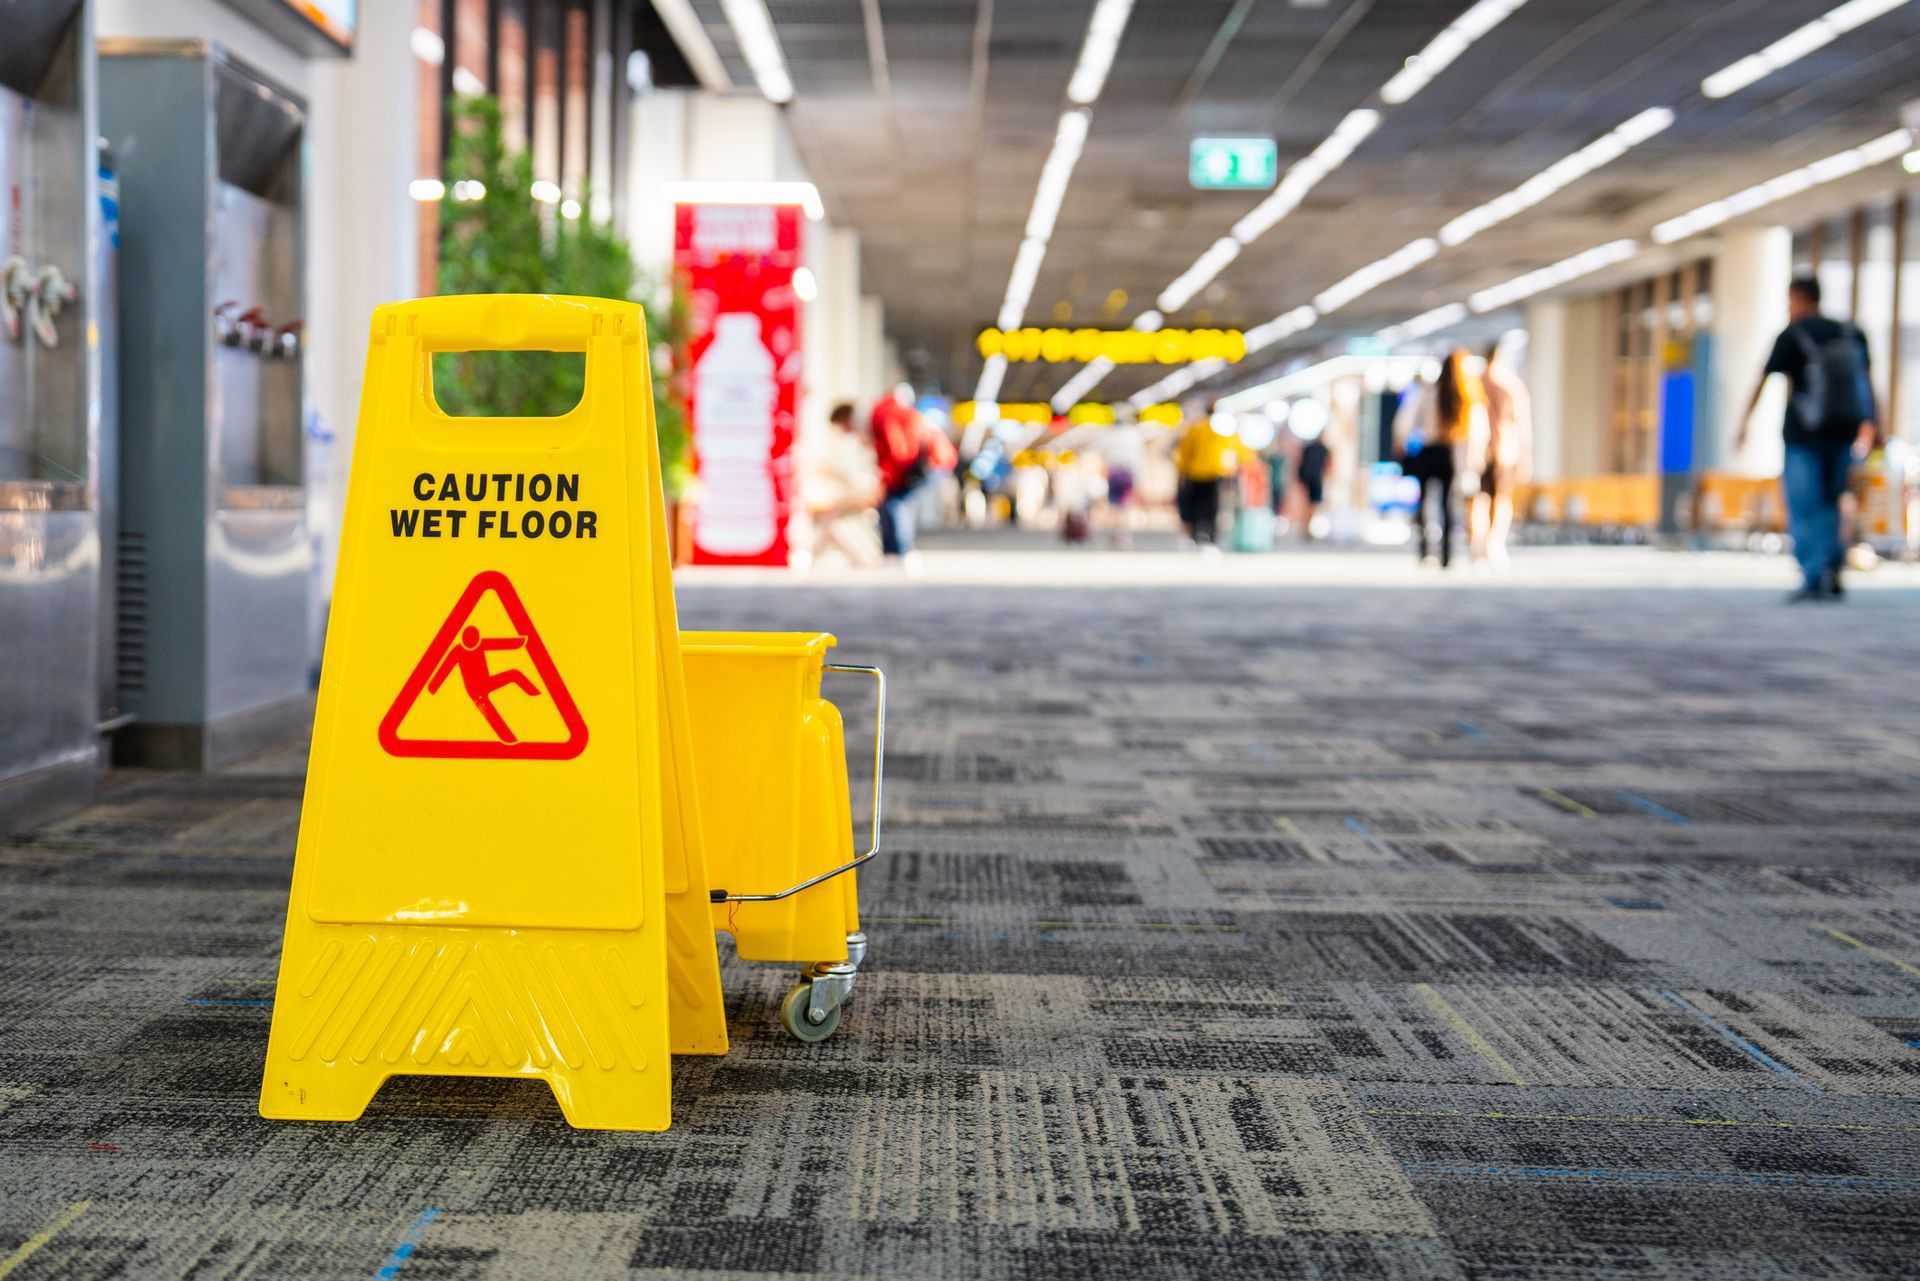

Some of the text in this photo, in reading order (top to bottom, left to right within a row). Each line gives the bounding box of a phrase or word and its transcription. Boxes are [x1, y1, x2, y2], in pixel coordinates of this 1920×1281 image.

[413, 472, 580, 502] CAUTION
[390, 509, 598, 539] WET FLOOR
